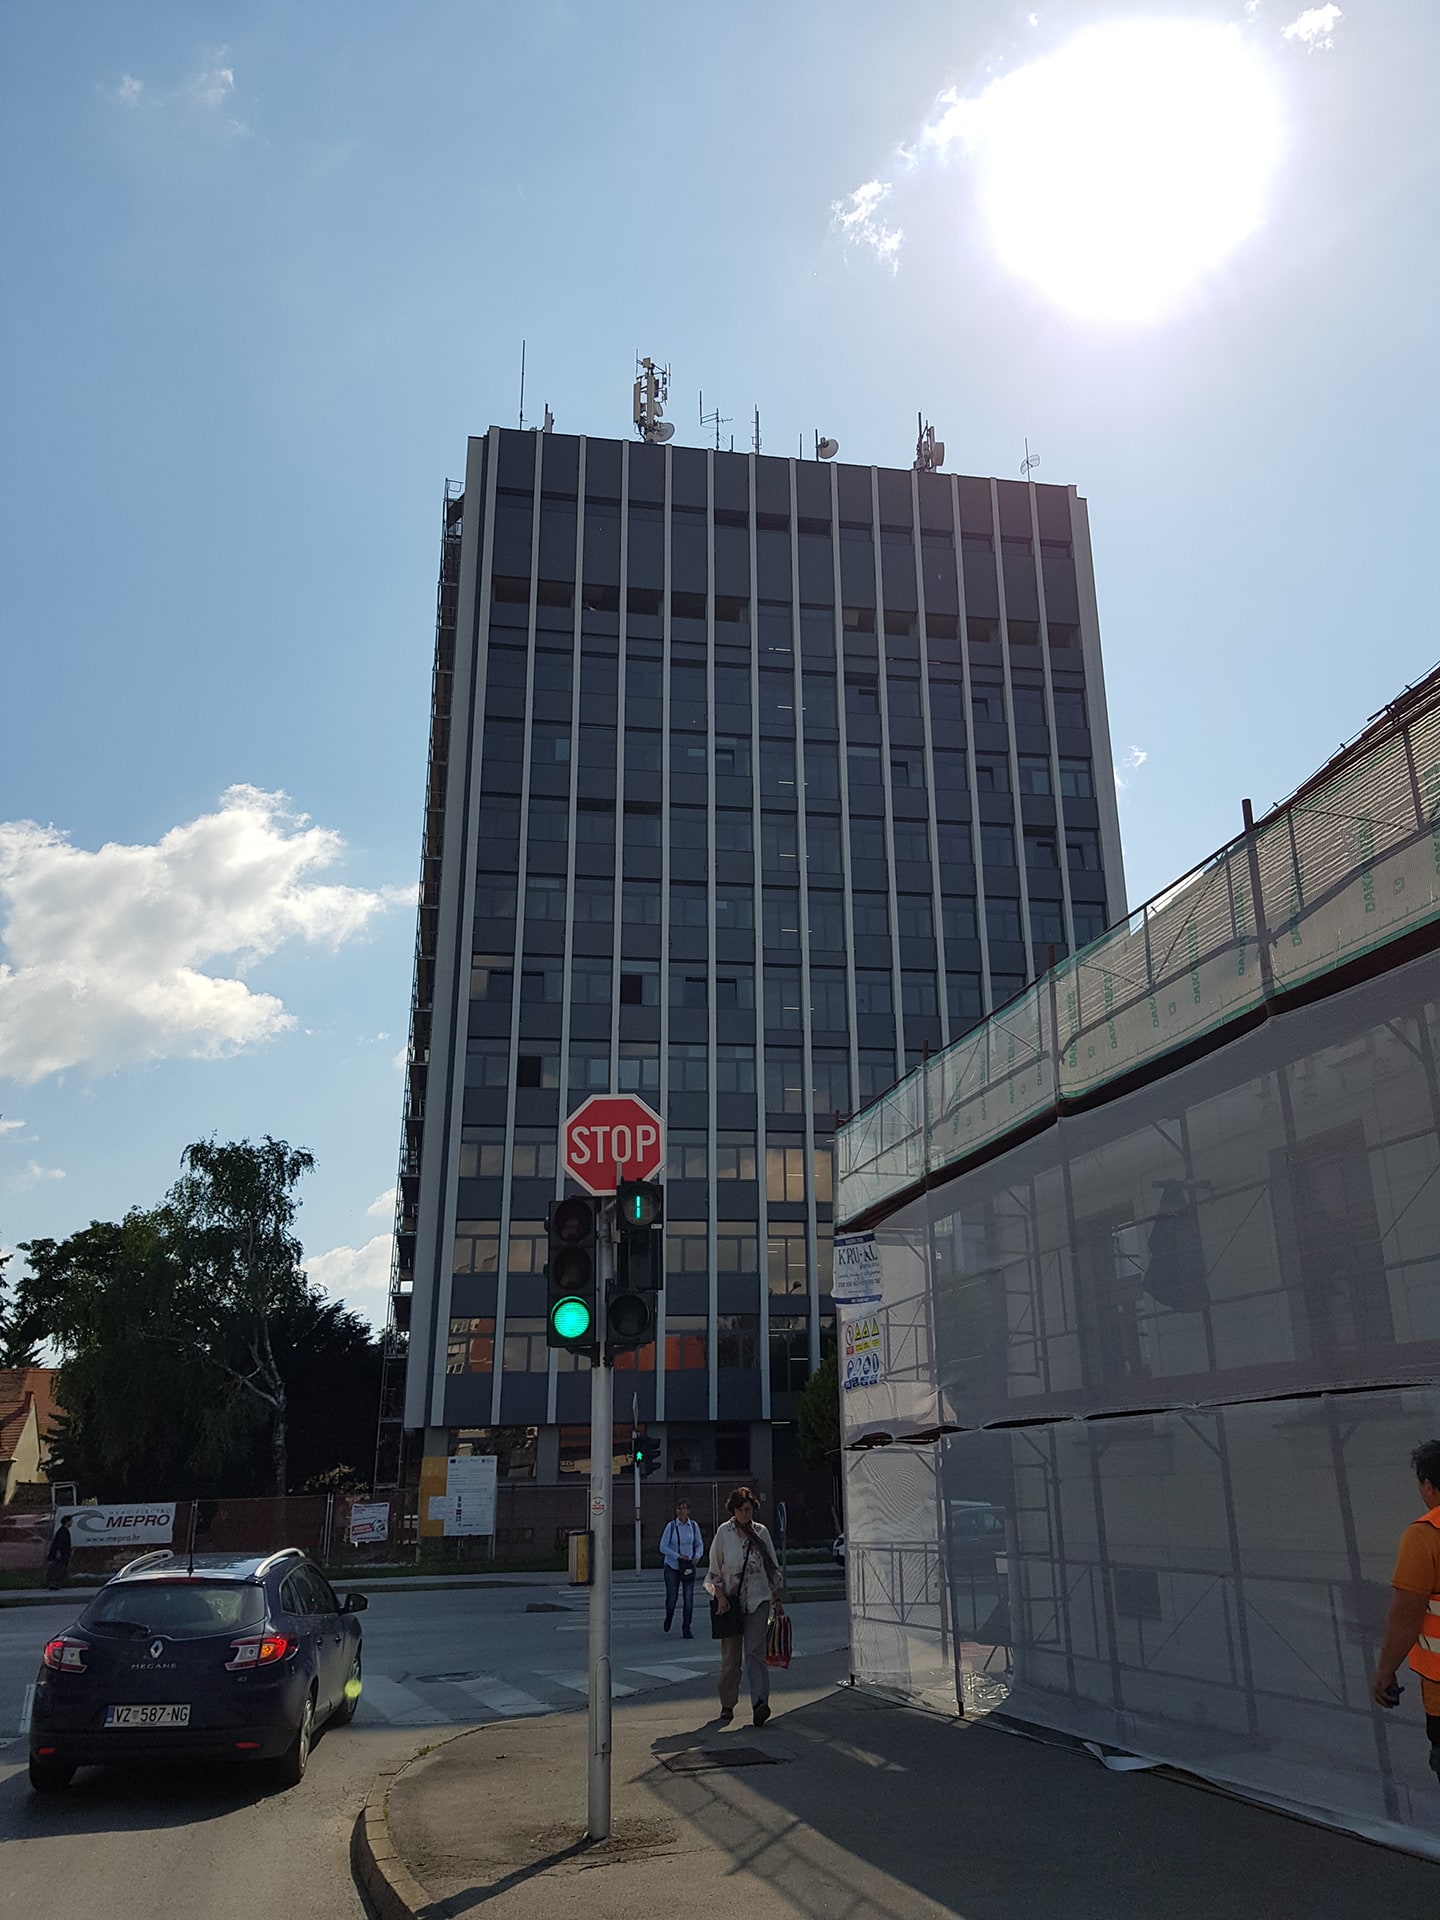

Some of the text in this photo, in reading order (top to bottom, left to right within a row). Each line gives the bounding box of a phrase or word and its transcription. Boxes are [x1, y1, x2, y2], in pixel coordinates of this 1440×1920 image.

[571, 1125, 656, 1164] STOP
[838, 1245, 878, 1265] KRU-AL
[106, 1515, 170, 1528] MEPRO
[87, 1534, 140, 1543] www.mepro.hr
[116, 1706, 189, 1722] VZ 587-NG
